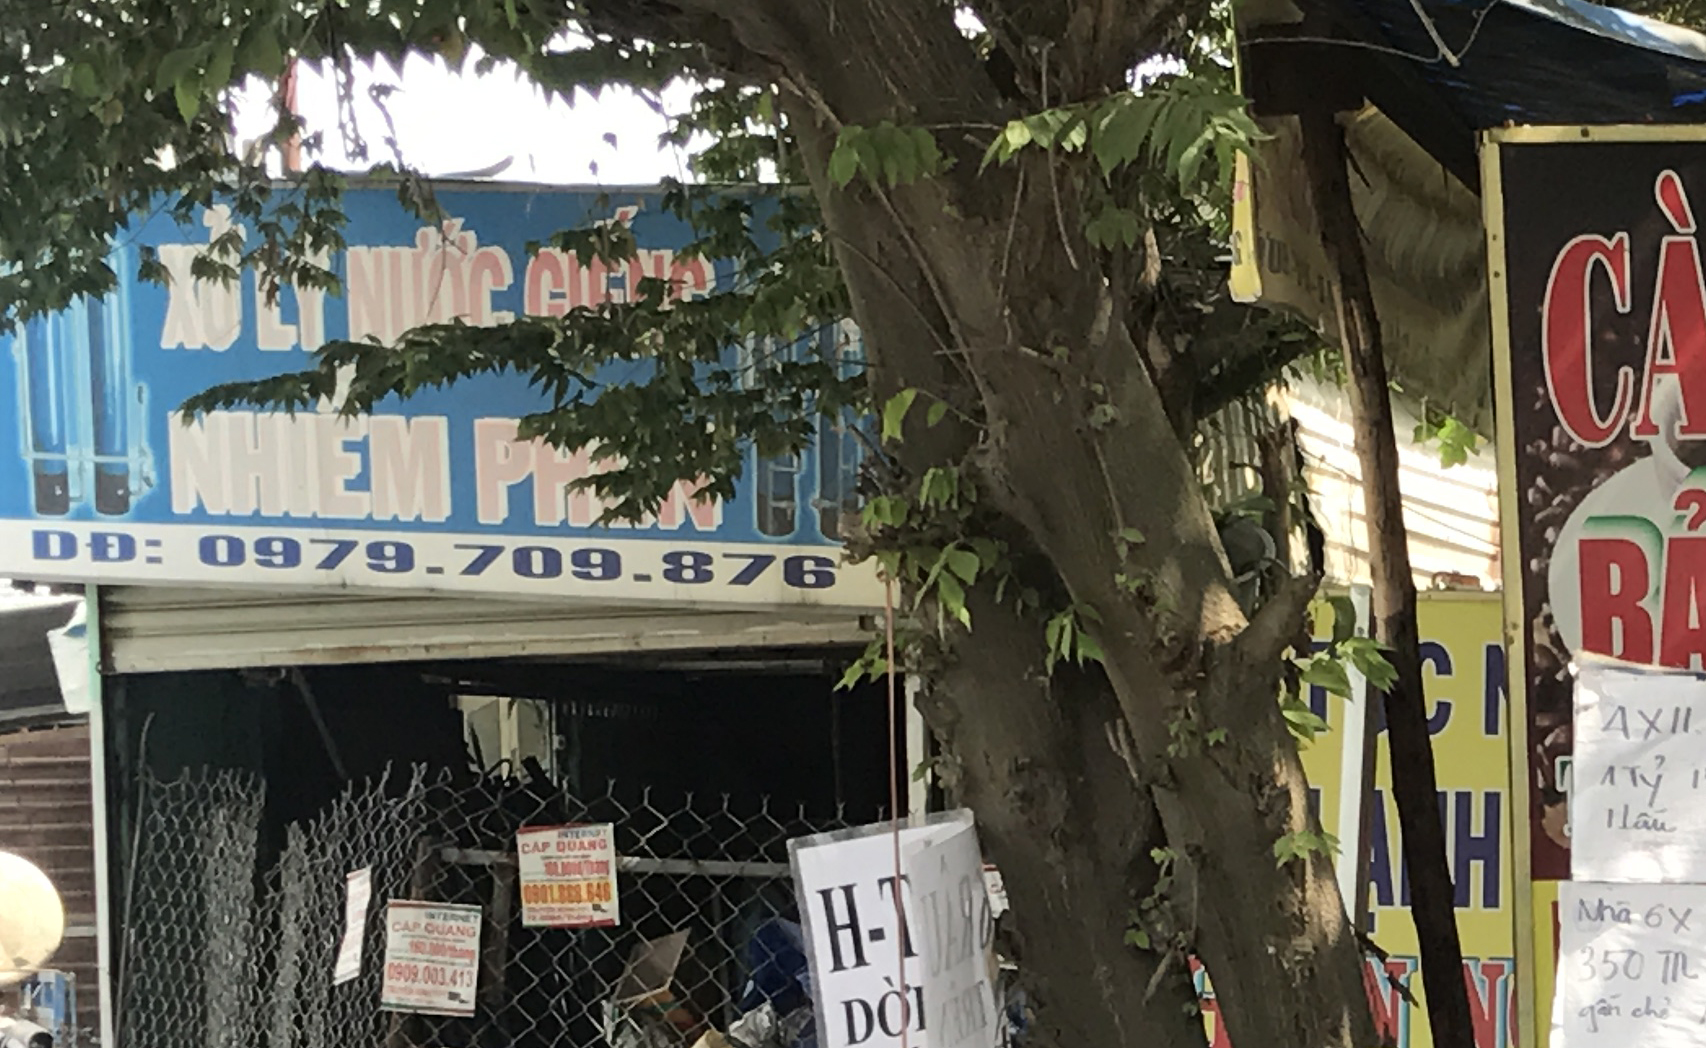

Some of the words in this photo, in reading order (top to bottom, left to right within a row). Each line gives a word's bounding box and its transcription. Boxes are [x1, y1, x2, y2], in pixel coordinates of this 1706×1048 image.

[346, 217, 513, 349] NƯỚC
[32, 529, 163, 566] DĐ:
[199, 535, 838, 591] 0979.709.876
[556, 838, 608, 854] QUANG
